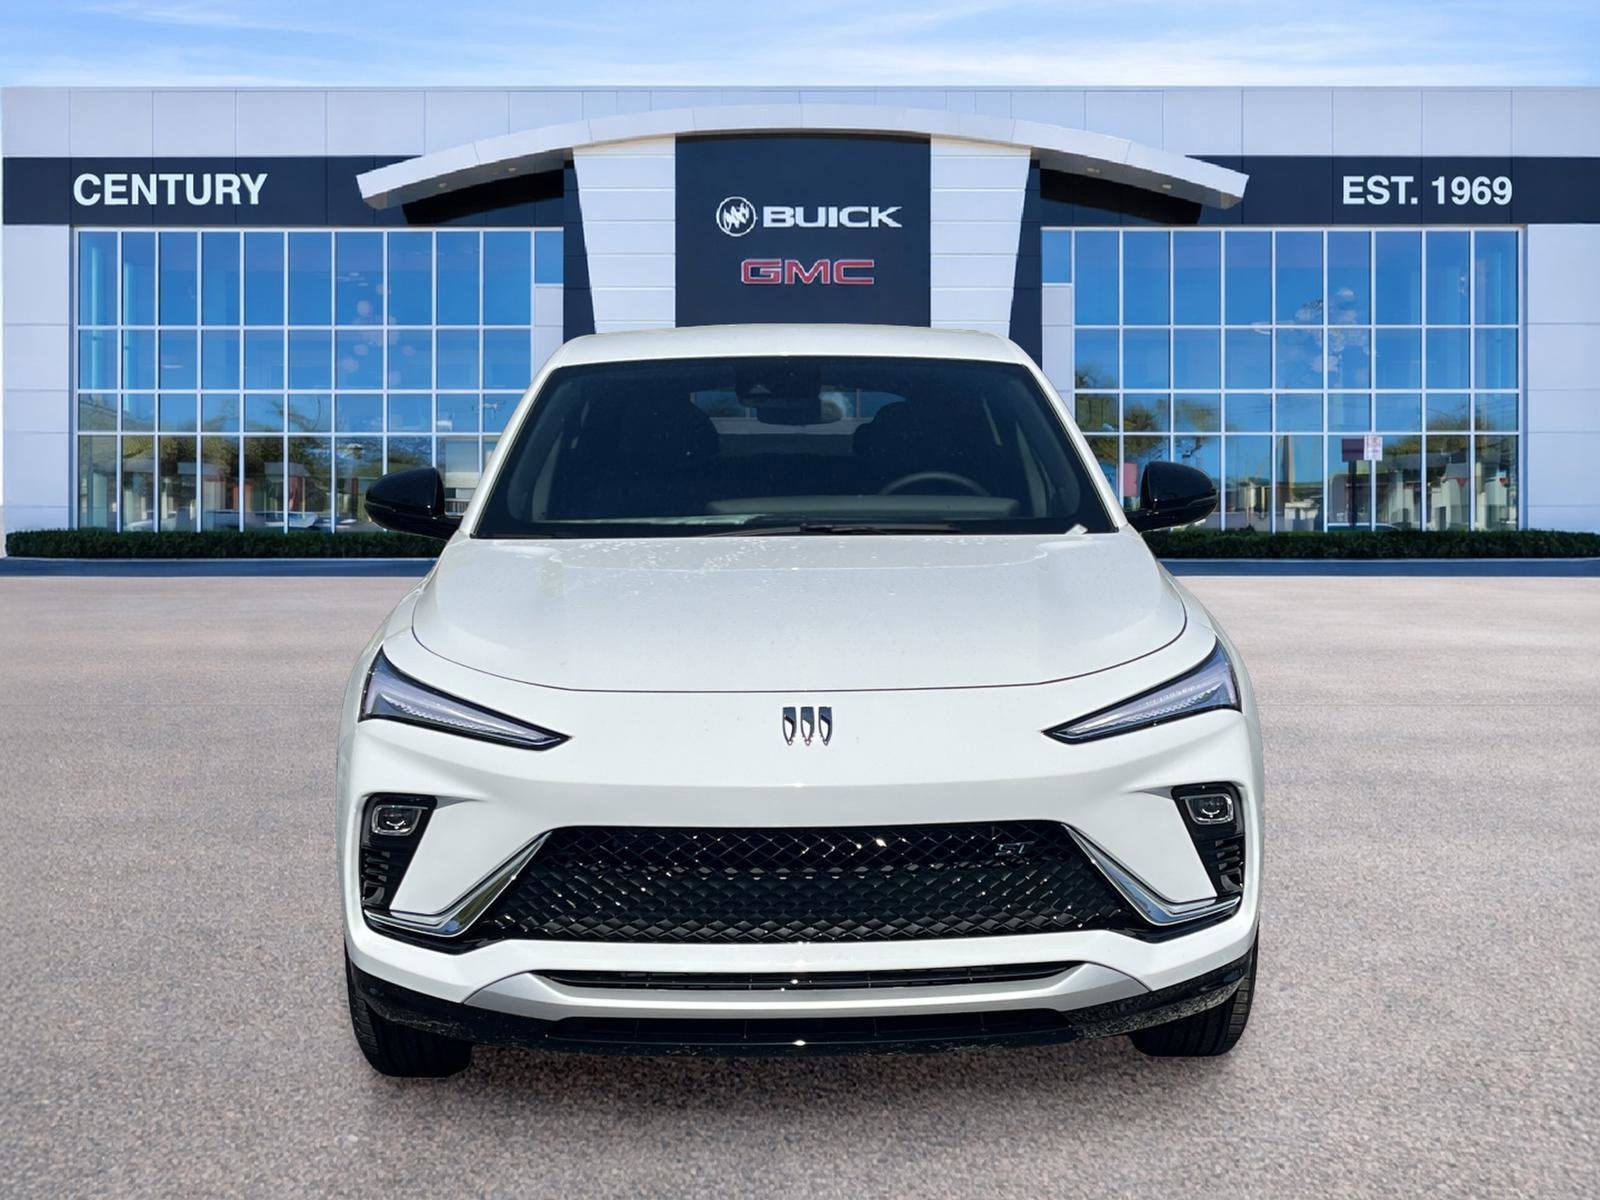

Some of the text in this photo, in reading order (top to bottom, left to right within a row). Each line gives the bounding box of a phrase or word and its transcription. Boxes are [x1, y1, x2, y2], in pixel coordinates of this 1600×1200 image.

[73, 172, 268, 206] CENTURY
[1342, 175, 1513, 206] EST. 1969
[763, 206, 902, 228] BUICK
[740, 258, 875, 285] GMC
